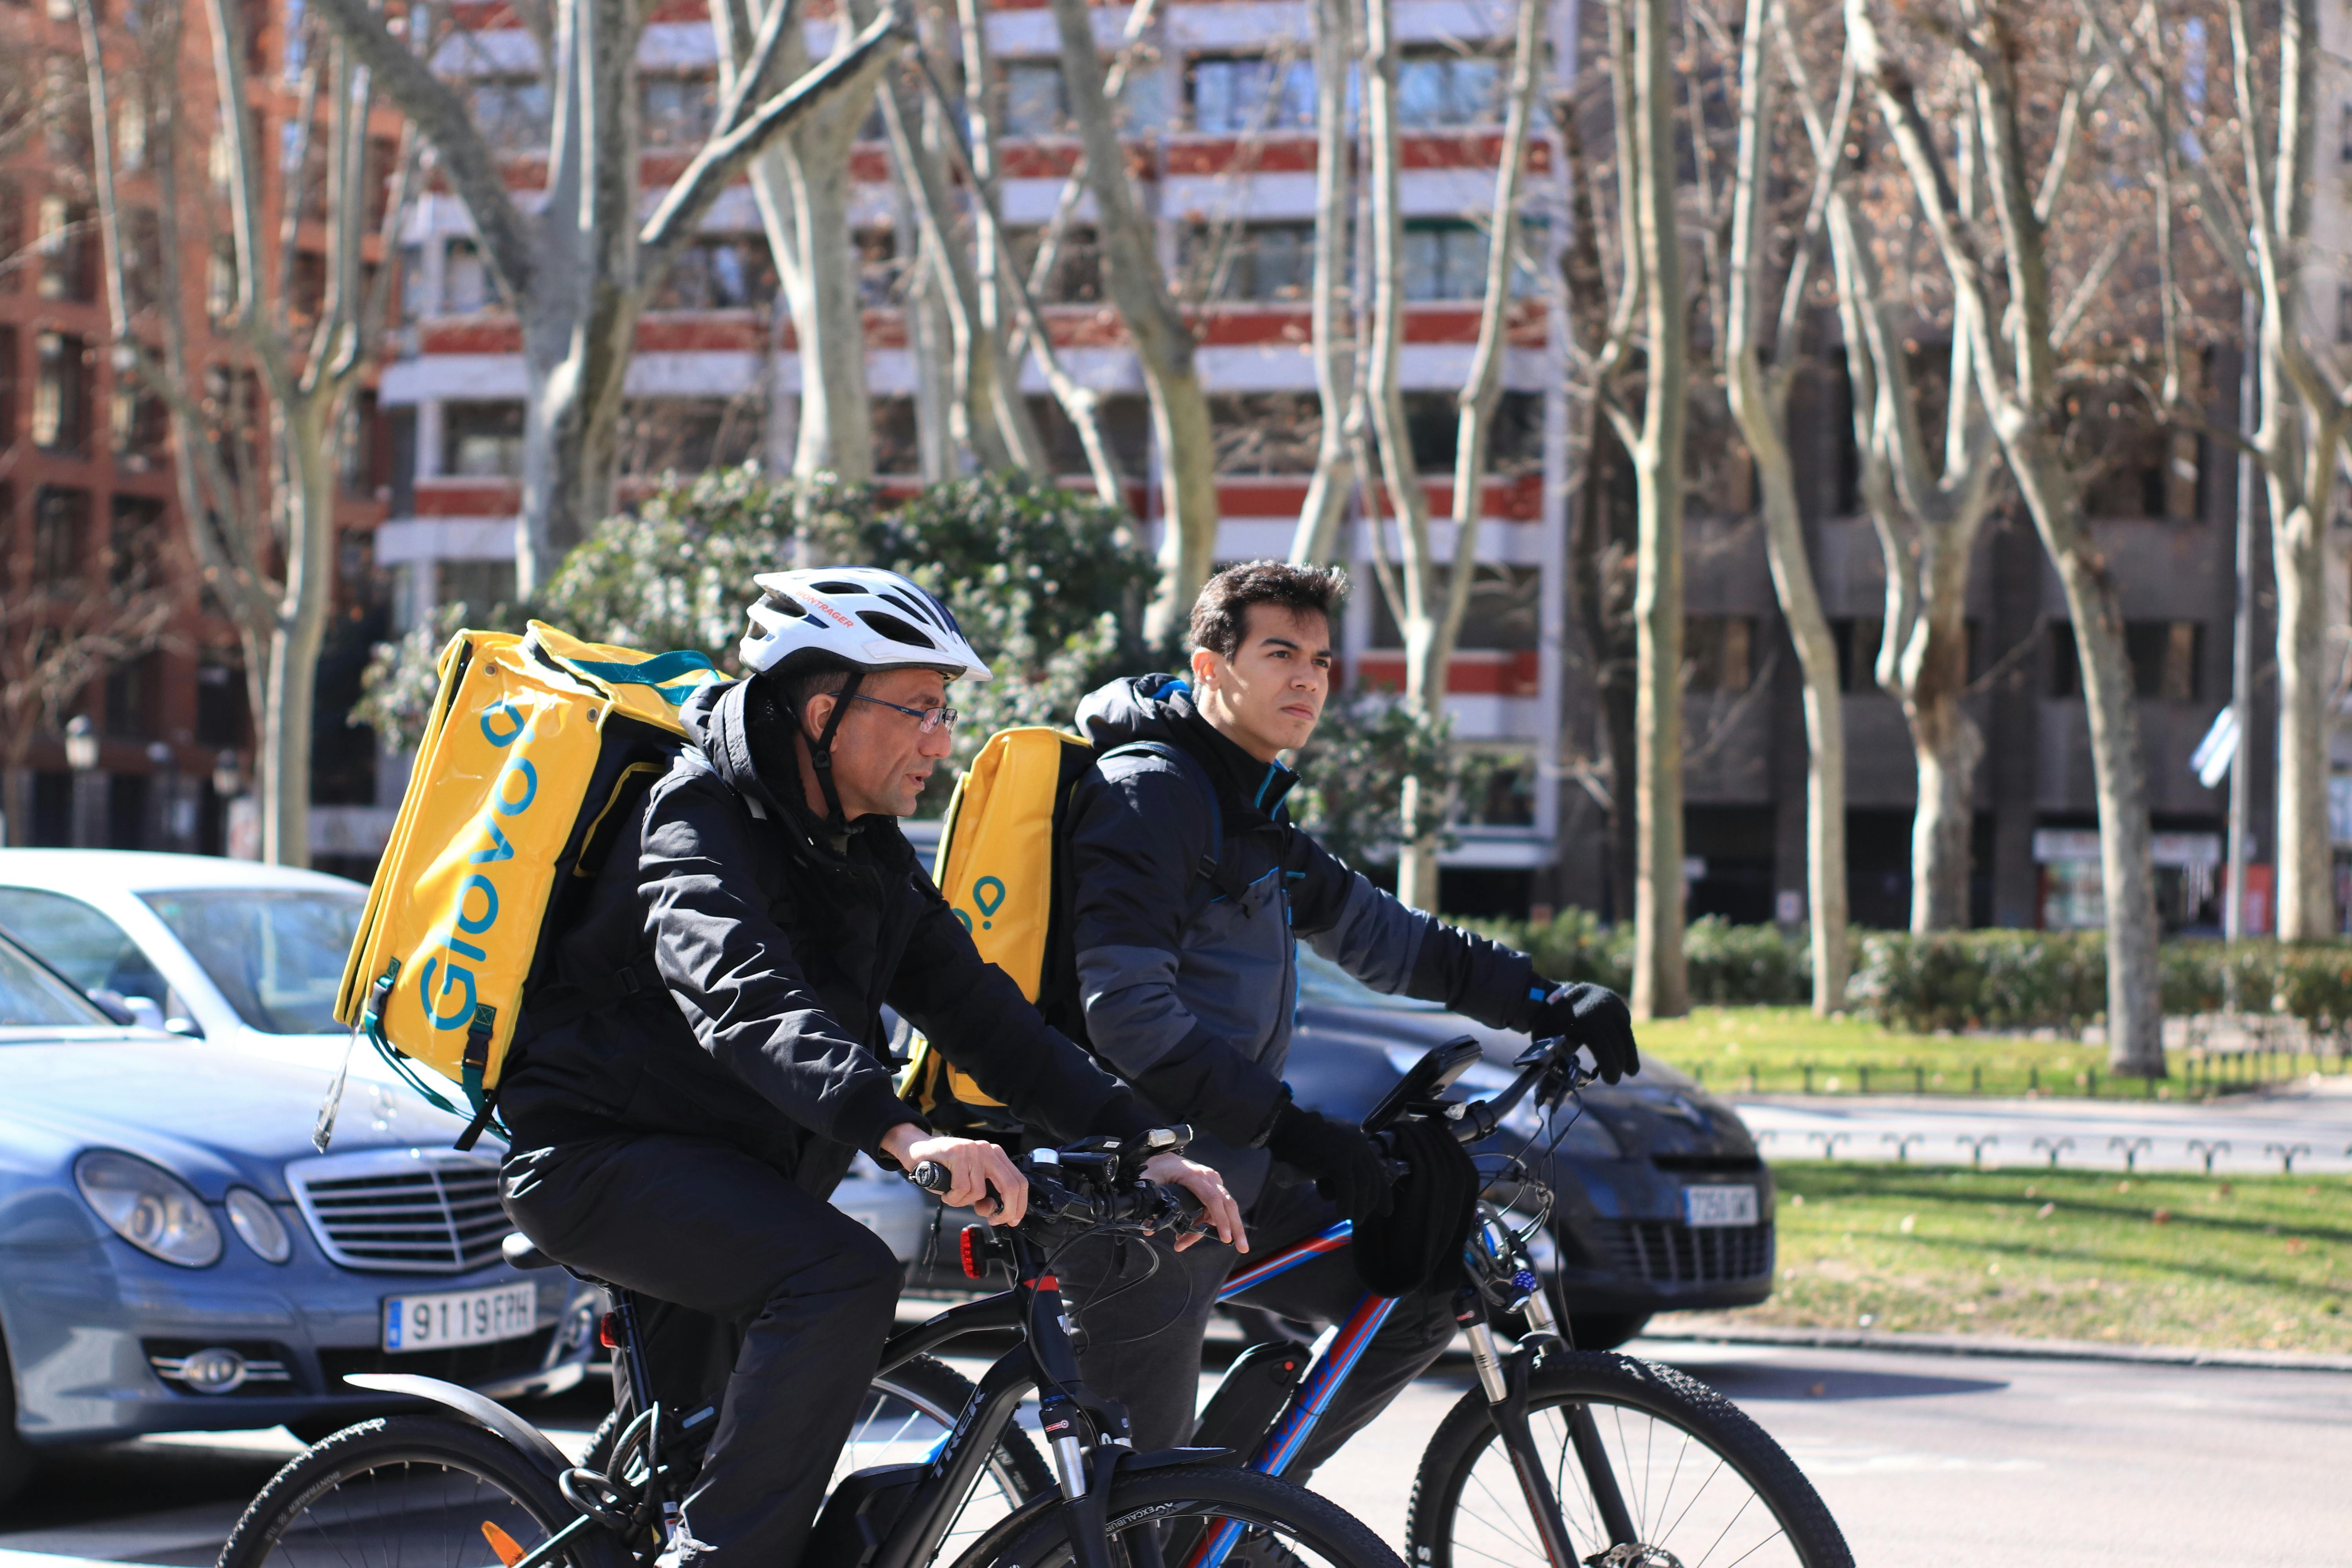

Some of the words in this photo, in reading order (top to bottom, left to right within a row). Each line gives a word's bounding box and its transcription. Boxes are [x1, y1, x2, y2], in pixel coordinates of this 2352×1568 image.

[796, 591, 854, 627] BONTRAGER
[420, 756, 537, 1031] Glovo
[930, 1385, 985, 1479] TREK
[1105, 1506, 1155, 1532] EXCALIBUR
